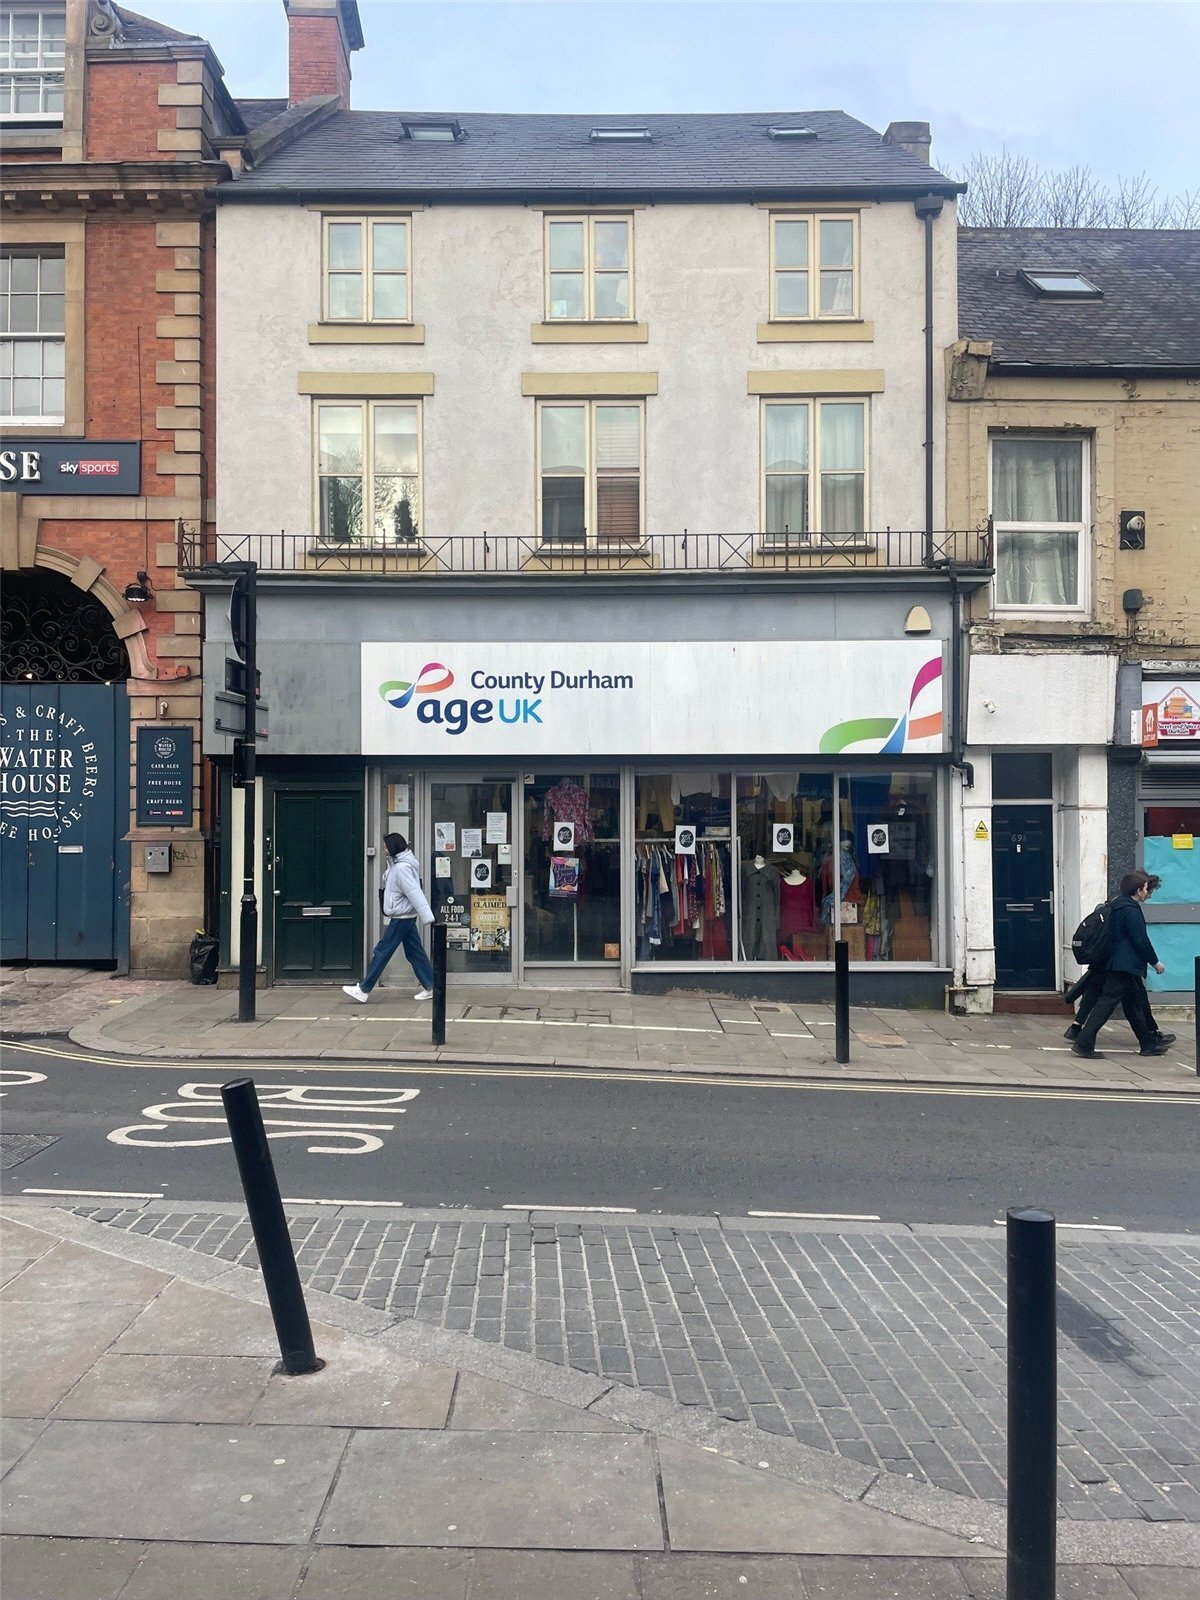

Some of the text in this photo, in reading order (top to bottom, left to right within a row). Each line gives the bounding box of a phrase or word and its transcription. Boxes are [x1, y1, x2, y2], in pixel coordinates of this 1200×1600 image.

[60, 461, 117, 474] sky sports
[470, 670, 634, 694] County Durham
[16, 729, 53, 741] THE
[0, 747, 73, 768] WATER
[35, 704, 85, 737] CRAFT
[81, 742, 98, 798] BEERS
[440, 905, 450, 914] ALL
[450, 905, 465, 914] FOOD
[105, 1082, 421, 1154] BUS
